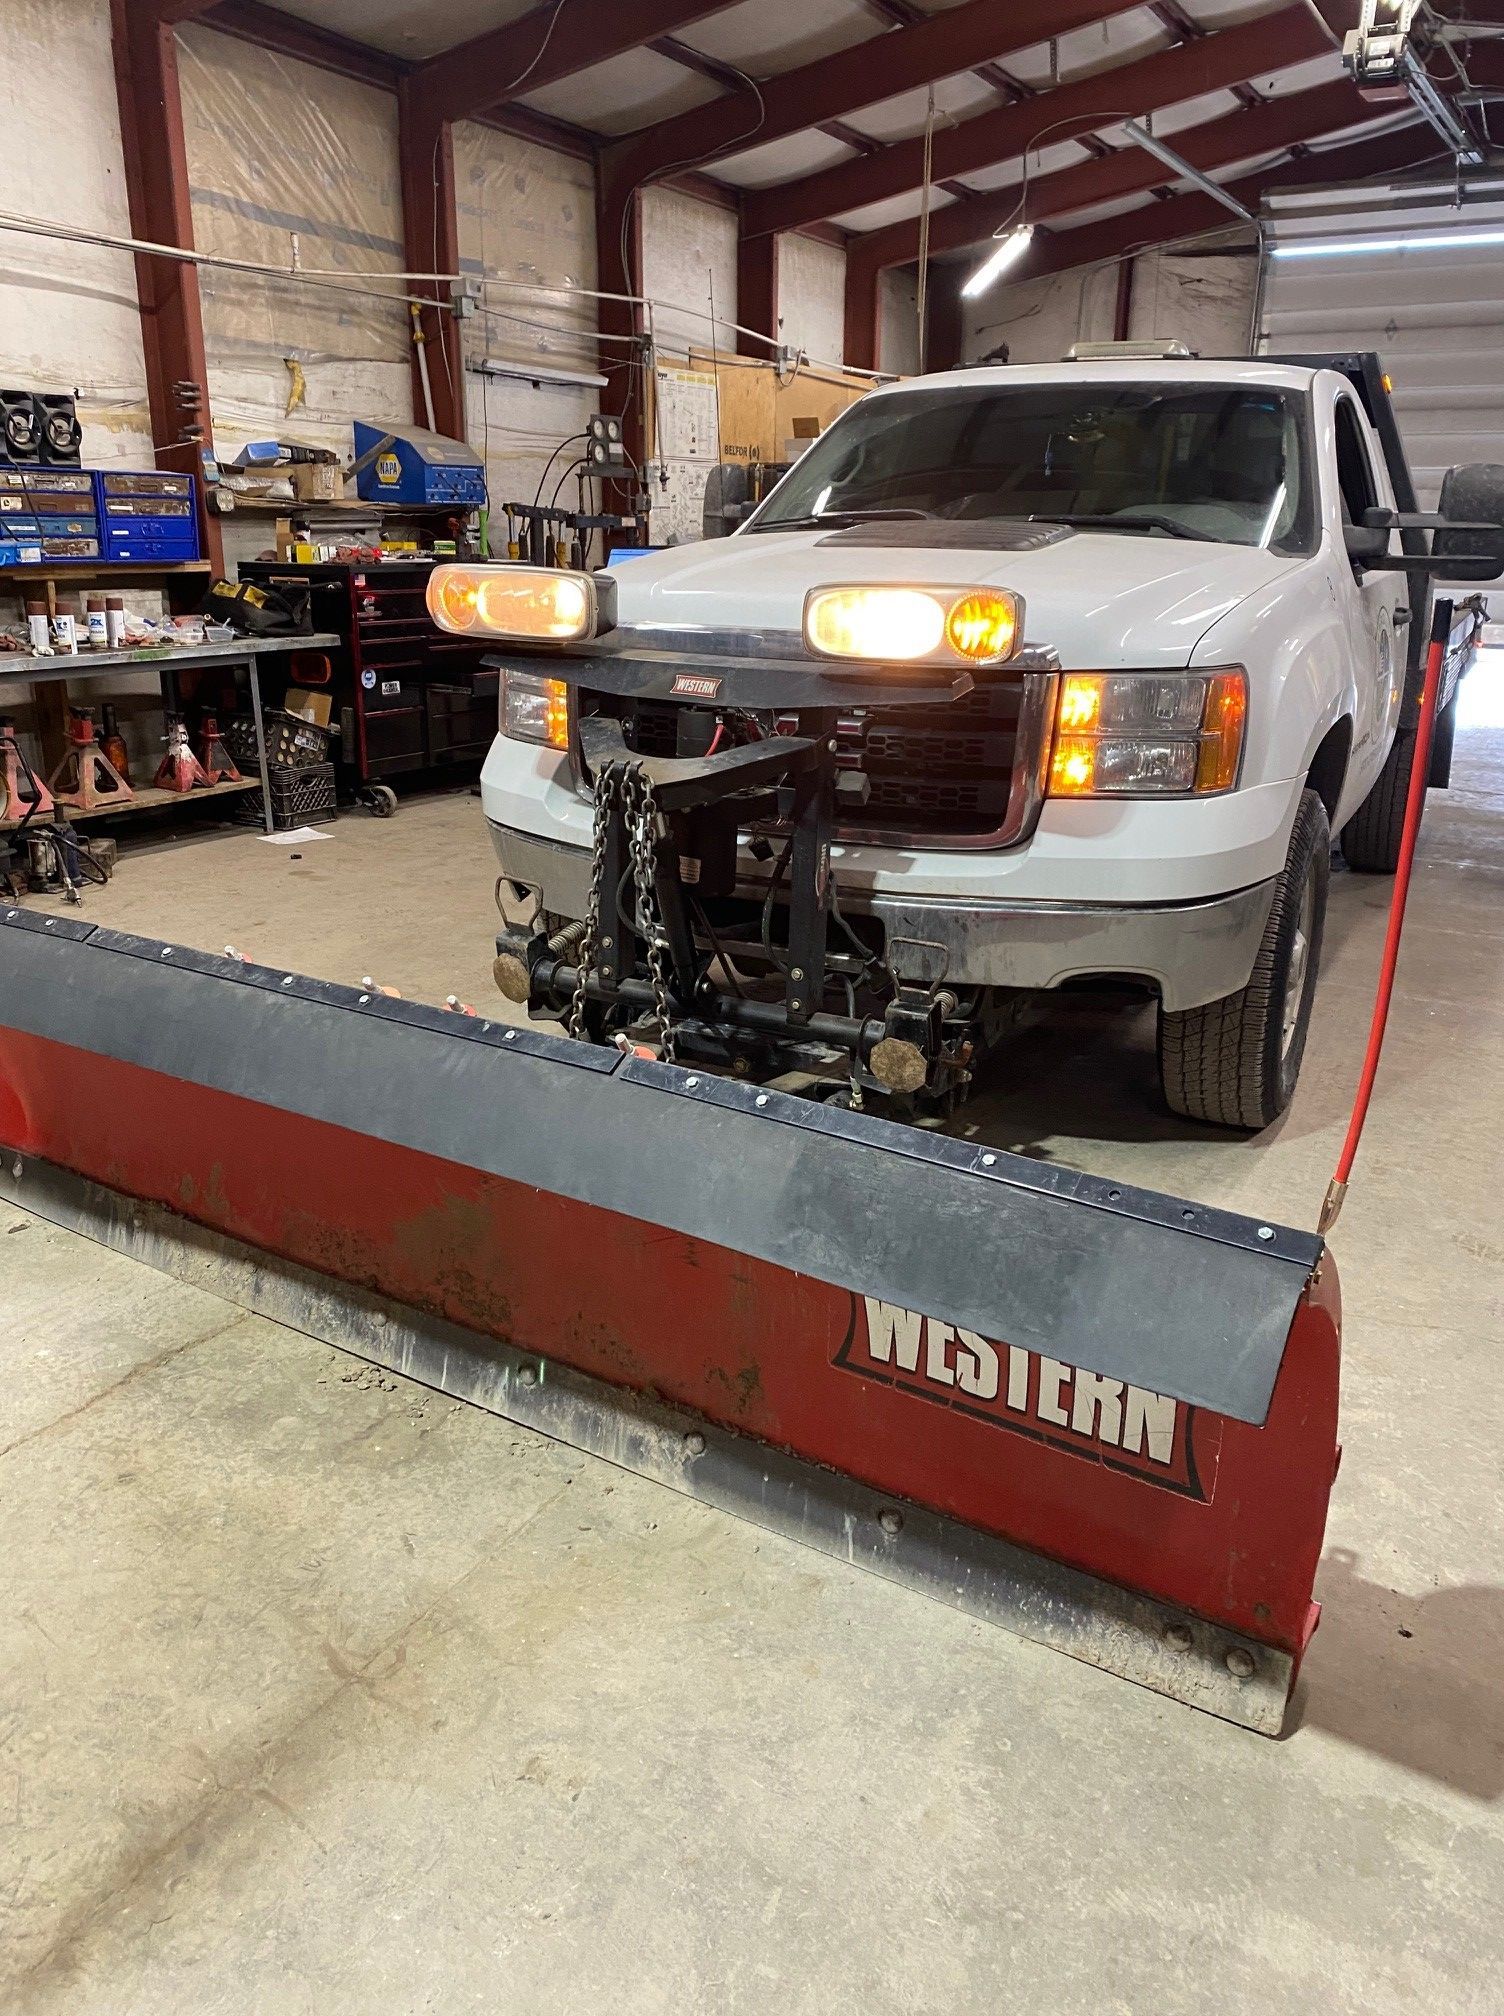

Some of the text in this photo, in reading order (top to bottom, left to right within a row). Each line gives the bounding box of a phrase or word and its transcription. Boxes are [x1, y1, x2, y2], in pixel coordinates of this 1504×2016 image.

[724, 444, 748, 457] BELFOR
[380, 461, 398, 475] NAPA
[90, 618, 104, 627] 2X
[677, 678, 716, 694] WESTERN
